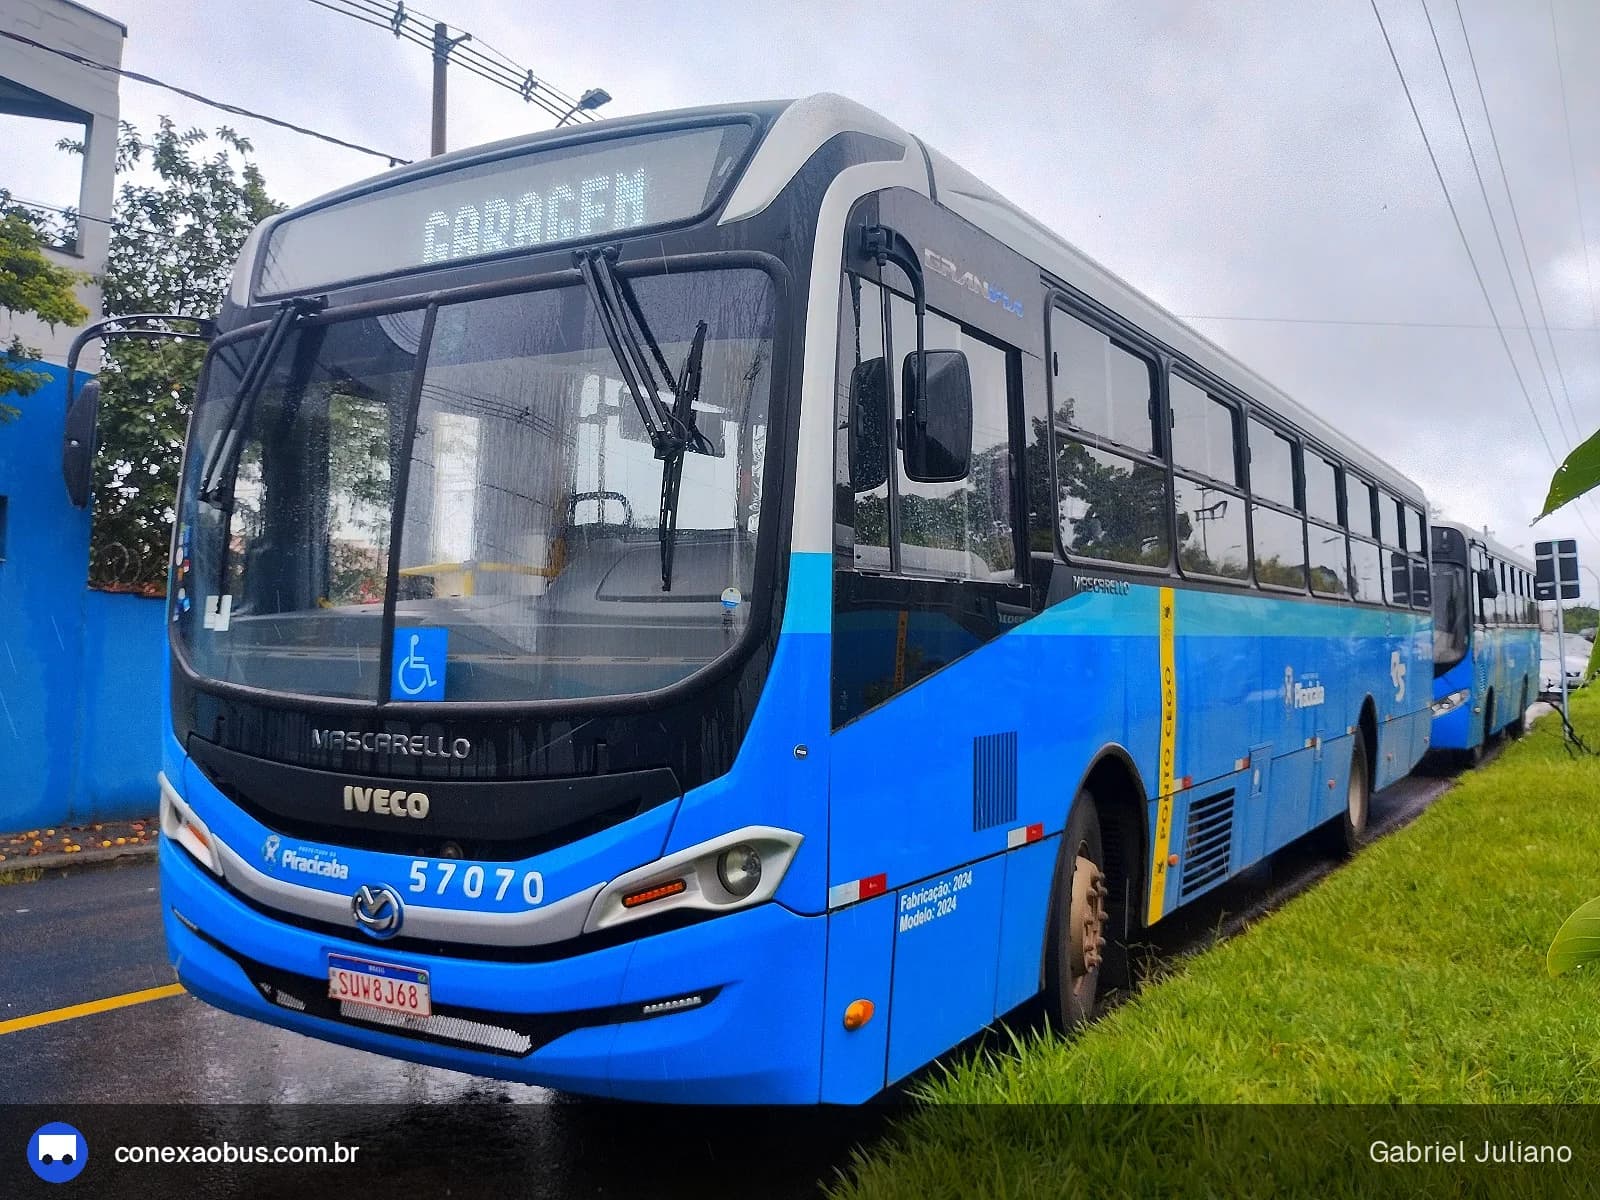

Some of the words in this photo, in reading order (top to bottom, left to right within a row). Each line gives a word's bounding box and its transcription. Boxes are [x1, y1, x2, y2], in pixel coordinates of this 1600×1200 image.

[1164, 665, 1173, 738] CEGO
[311, 728, 471, 759] MASCARELLO
[343, 785, 430, 819] IVECO
[282, 849, 349, 880] Piracicaba
[409, 859, 544, 905] 57070
[900, 880, 951, 912] Fabricação:
[953, 870, 973, 891] 2024
[899, 907, 935, 932] Modelo:
[937, 895, 957, 916] 2024
[338, 972, 418, 1008] SUW8J68
